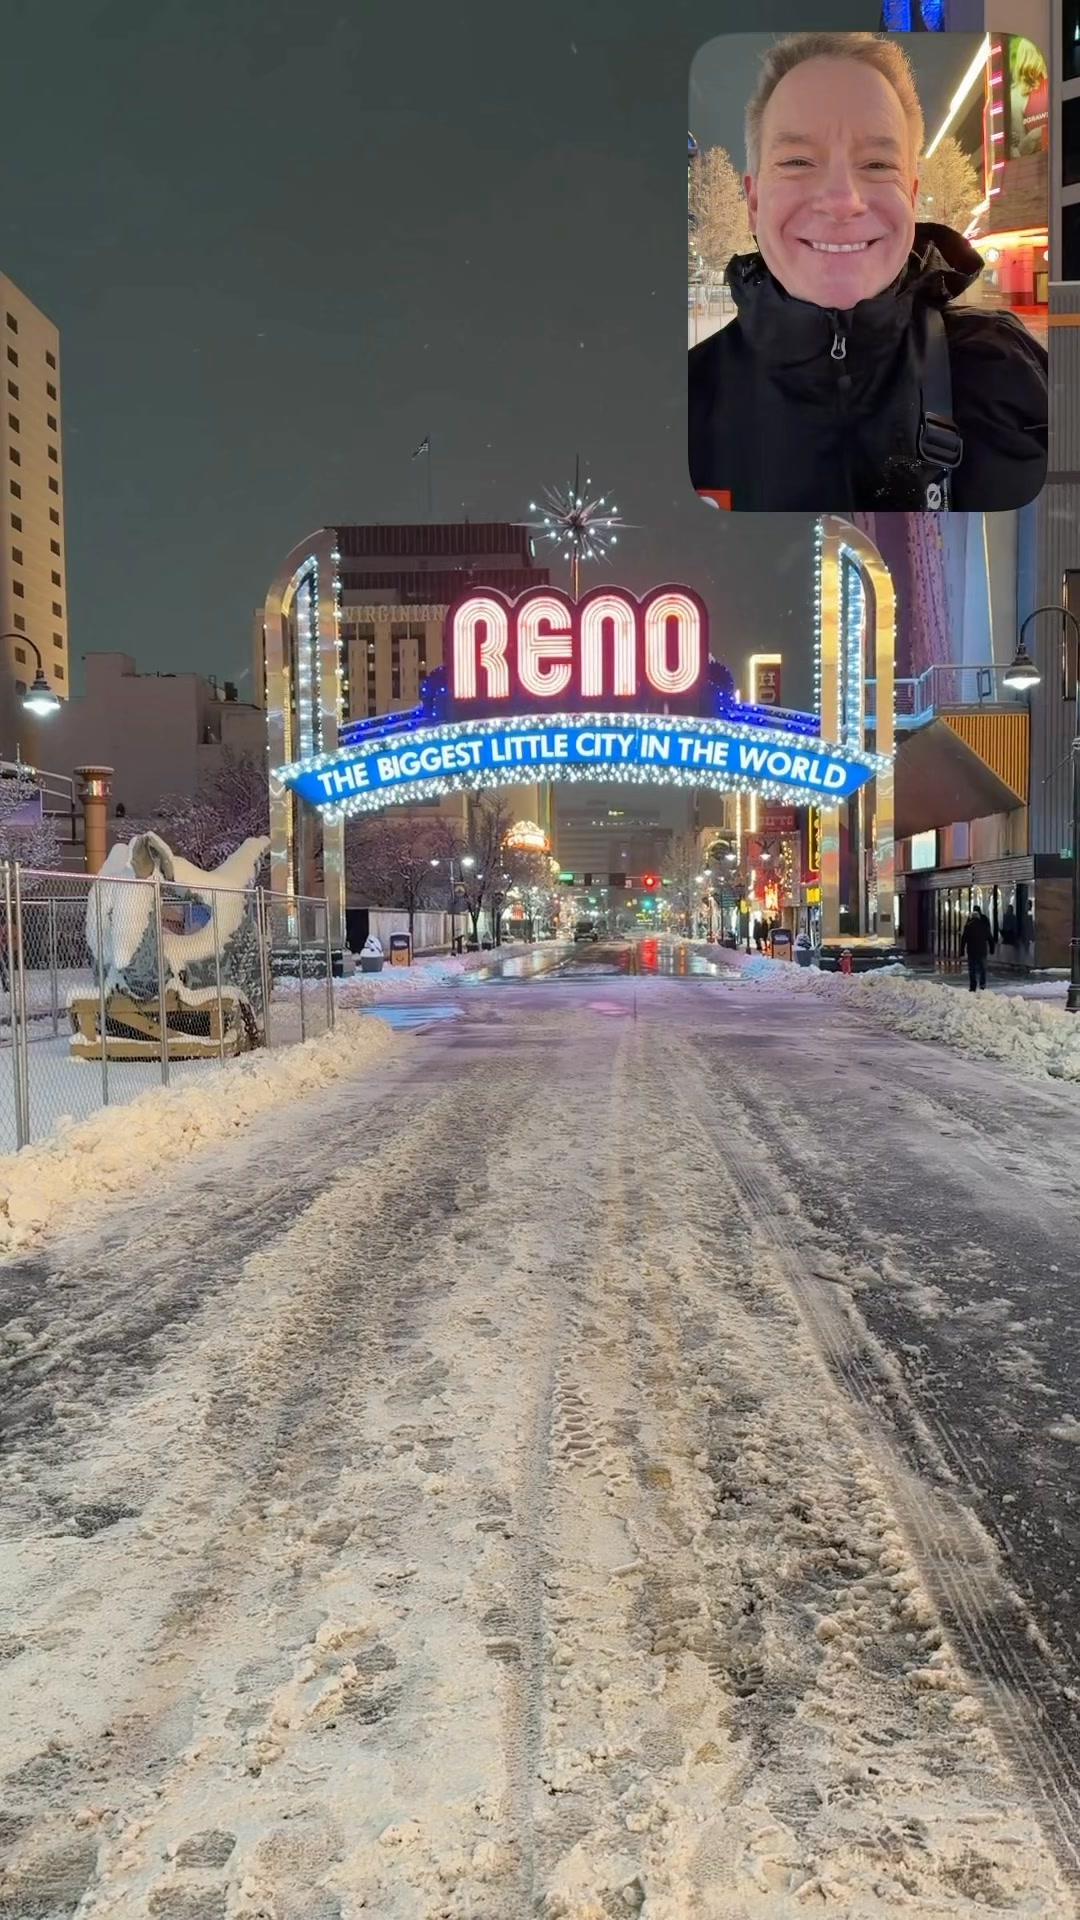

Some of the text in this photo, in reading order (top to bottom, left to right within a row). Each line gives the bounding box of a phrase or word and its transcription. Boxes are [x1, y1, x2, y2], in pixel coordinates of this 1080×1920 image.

[343, 604, 446, 623] VIRGINIAN
[452, 593, 701, 699] RENO
[317, 732, 847, 796] THE BIGGEST LITTLE CITY IN THE WORLD
